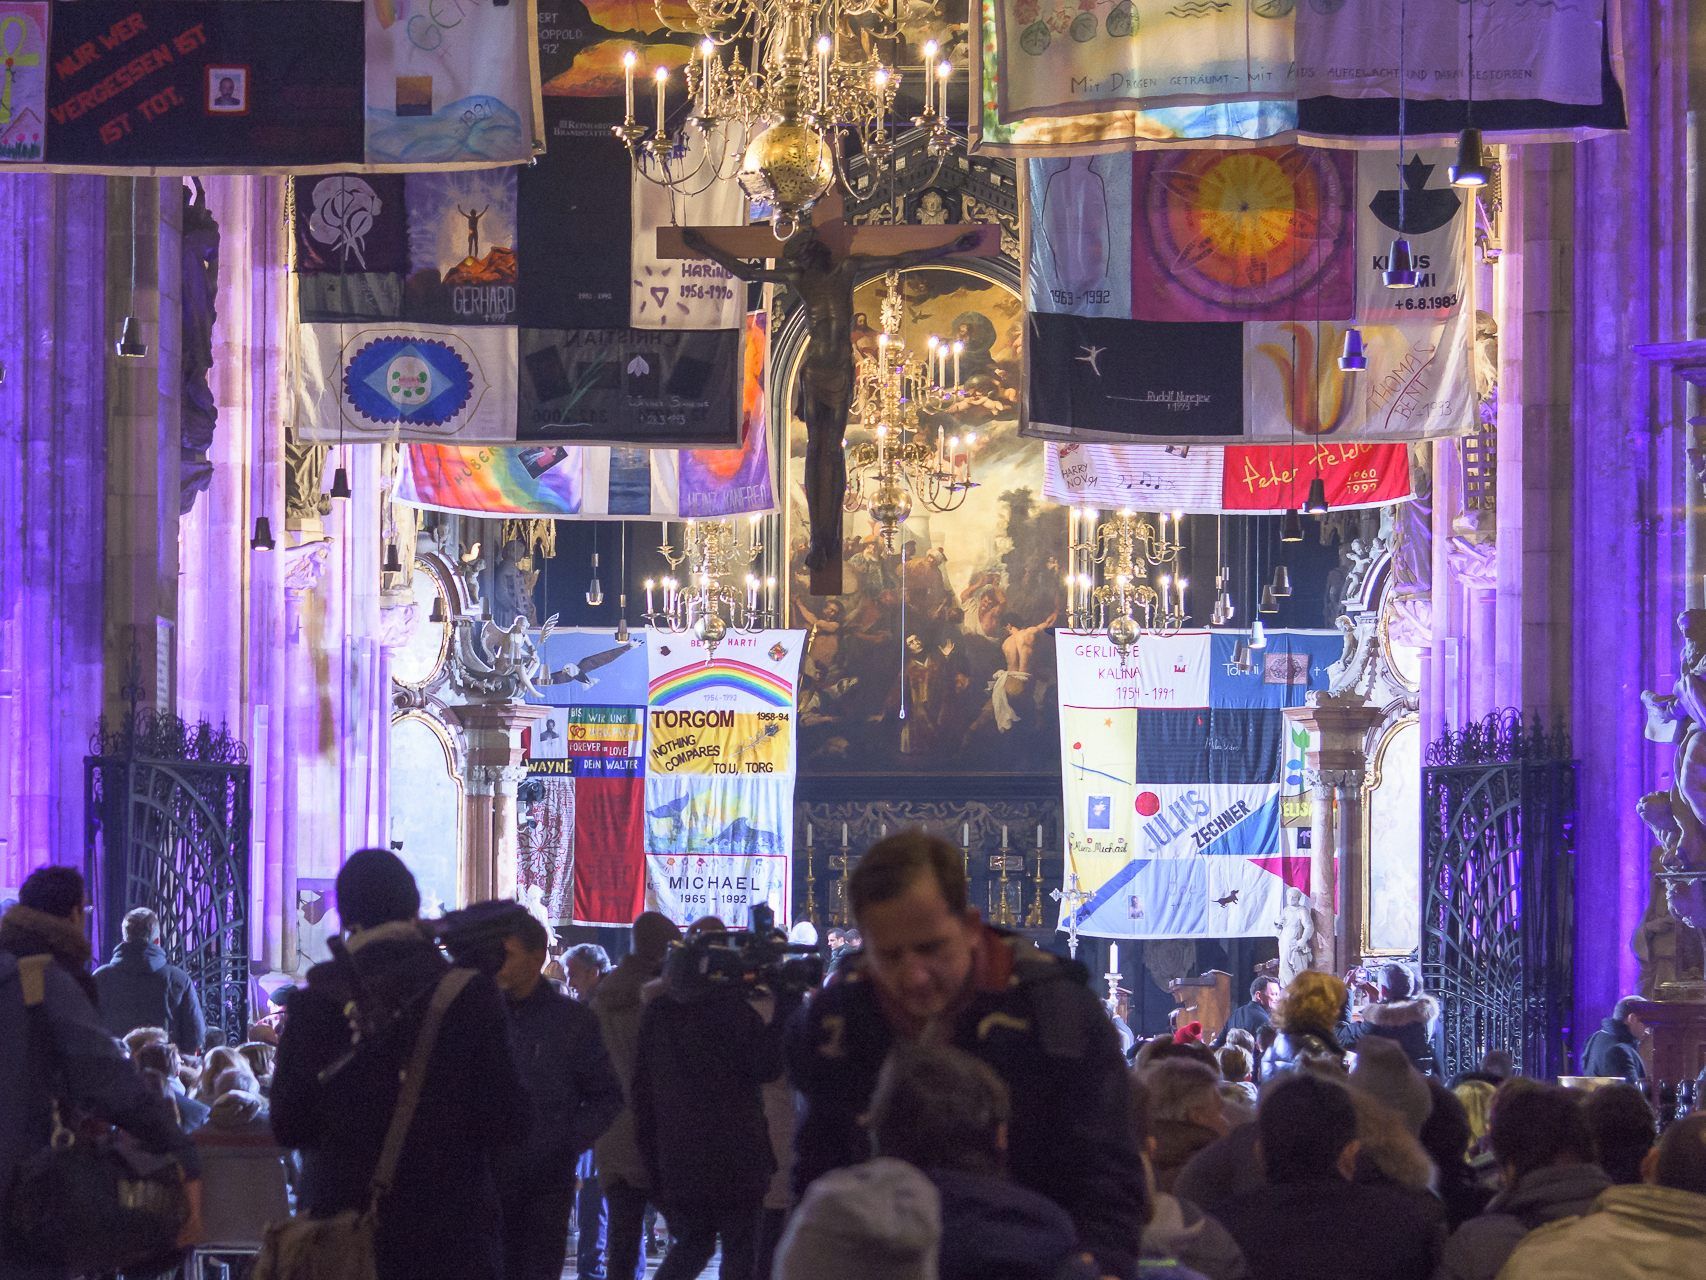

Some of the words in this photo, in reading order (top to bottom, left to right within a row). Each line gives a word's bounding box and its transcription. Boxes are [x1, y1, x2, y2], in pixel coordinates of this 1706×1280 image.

[56, 41, 102, 80] NUR
[98, 12, 147, 50] WER
[50, 44, 174, 125] VERGESSEN
[172, 23, 207, 56] IST
[100, 112, 131, 145] IST
[453, 286, 516, 315] GERHARD
[1075, 645, 1140, 658] GERLINE
[1098, 667, 1142, 680] KALINA
[1116, 687, 1140, 700] 1954
[1152, 688, 1175, 700] 1991
[588, 713, 606, 724] WIR
[651, 710, 735, 729] TORGOM
[757, 711, 789, 721] 1958-94
[609, 746, 628, 757] LOVE
[653, 735, 696, 759] NOTHING
[605, 759, 639, 770] WALTER
[665, 745, 721, 772] COMPARES
[745, 762, 774, 773] TORG
[1142, 789, 1211, 854] JULIUS
[1190, 799, 1251, 849] ZECHNER
[668, 876, 760, 891] MICHAEL
[680, 894, 706, 905] 1965
[721, 894, 747, 905] 1992
